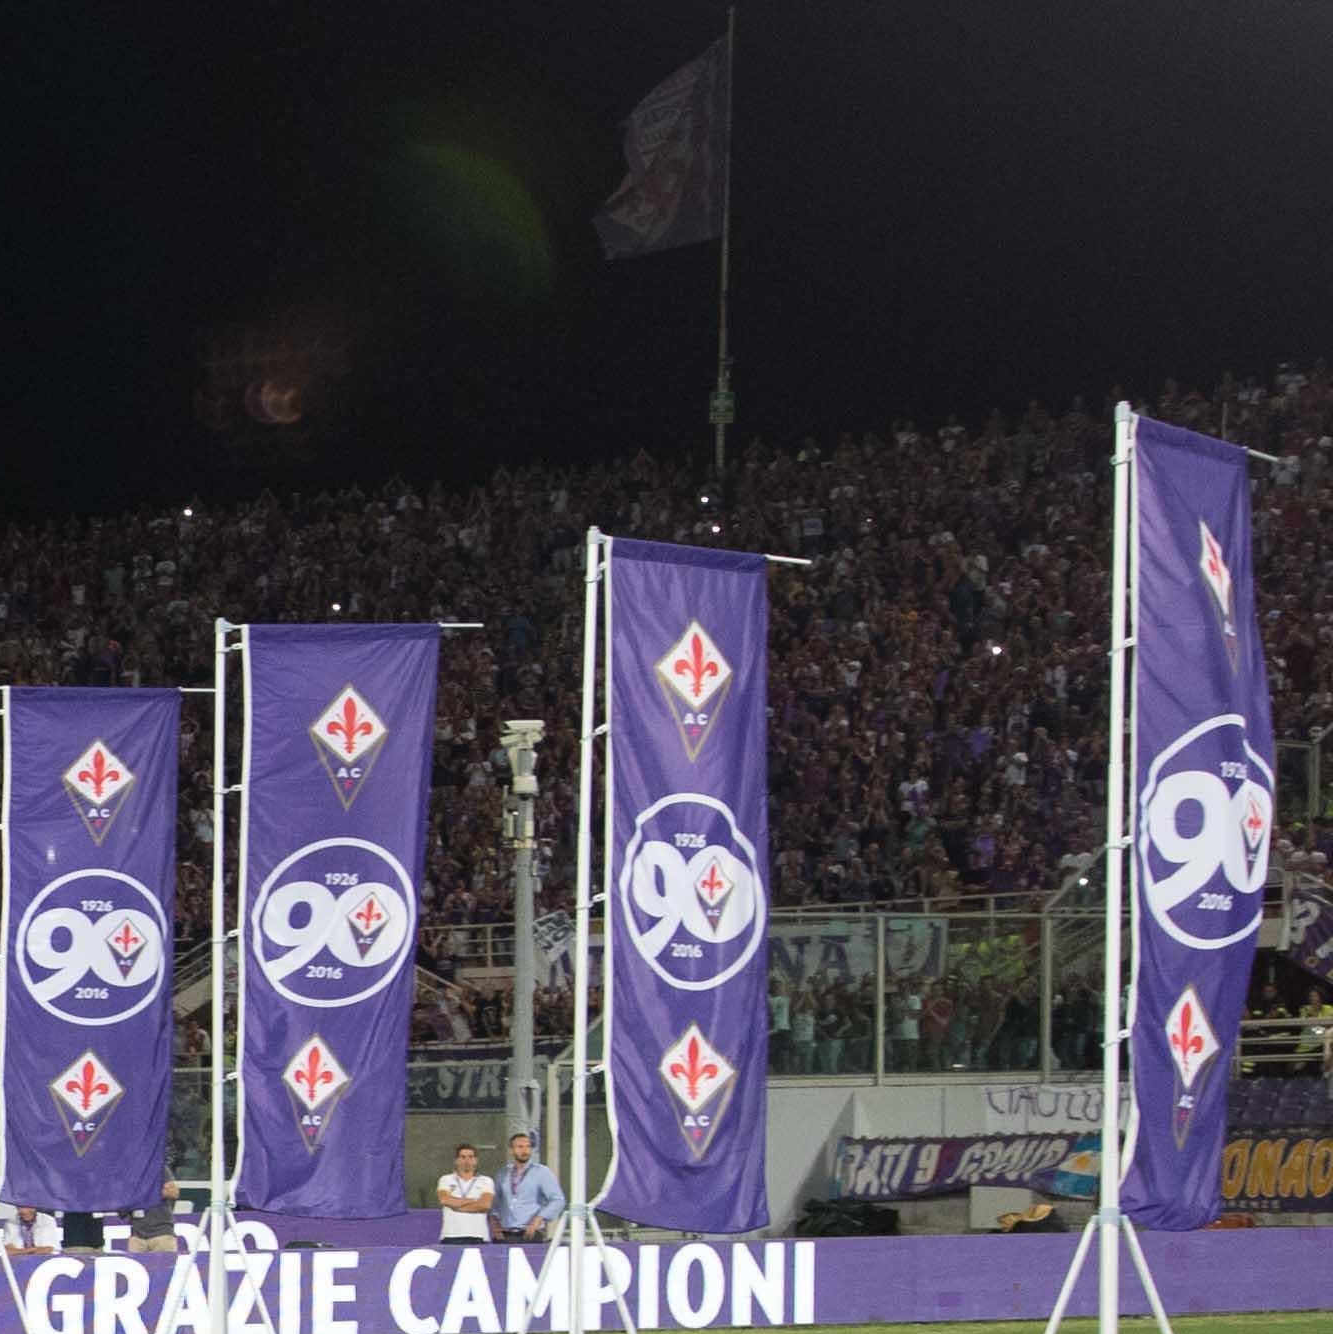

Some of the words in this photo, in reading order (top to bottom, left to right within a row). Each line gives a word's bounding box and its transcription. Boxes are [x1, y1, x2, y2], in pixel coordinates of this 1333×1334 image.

[673, 833, 707, 849] 1926
[1148, 770, 1273, 912] 90
[324, 873, 360, 887] 1926
[80, 899, 115, 913] 1926
[631, 841, 756, 959] 90
[1197, 892, 1234, 912] 2016
[261, 881, 408, 981] 90
[26, 907, 162, 1003] 90
[670, 943, 704, 959] 2016
[304, 965, 344, 981] 2016
[74, 986, 110, 1000] 2016
